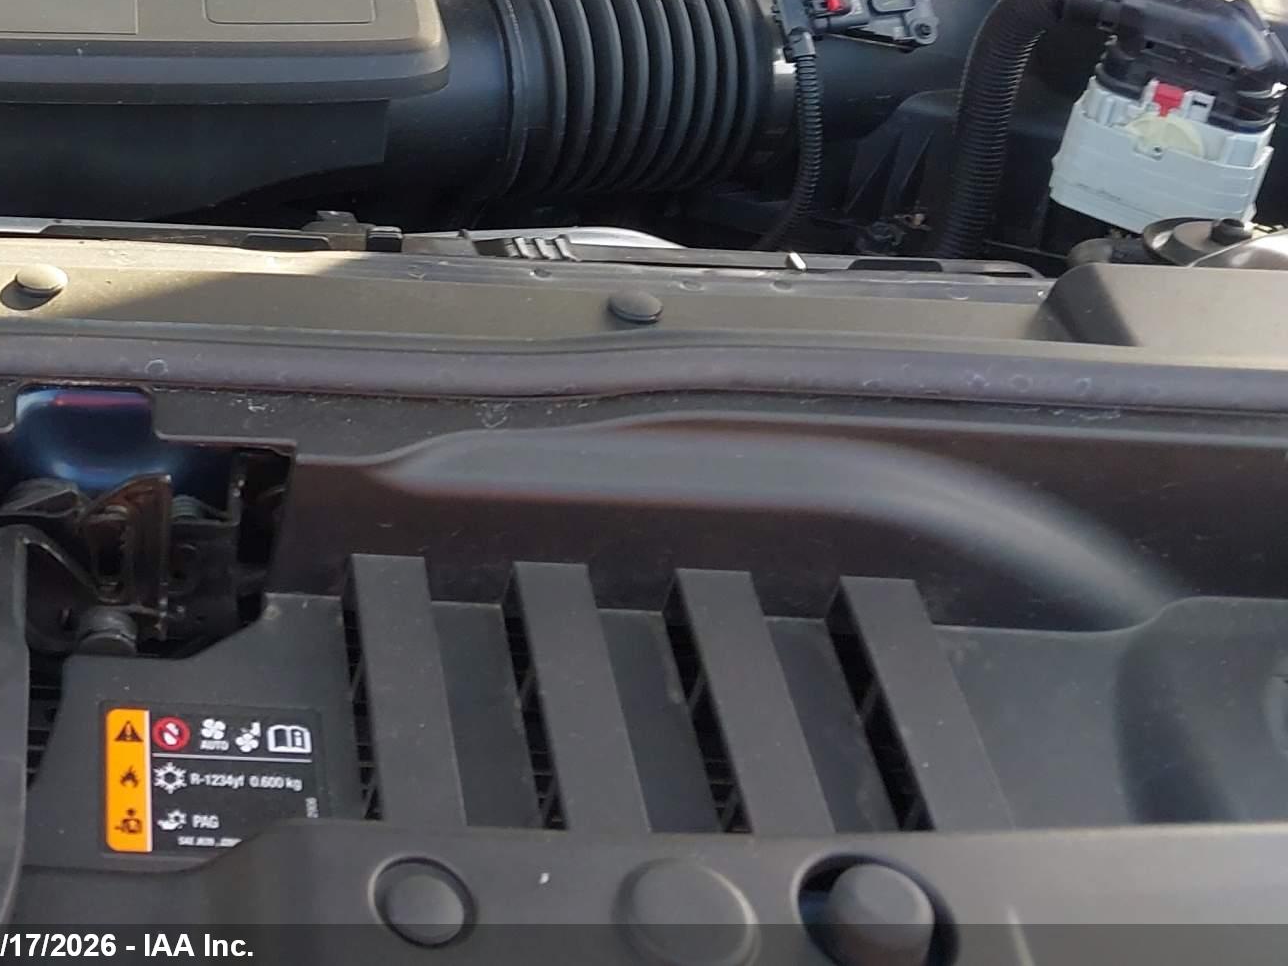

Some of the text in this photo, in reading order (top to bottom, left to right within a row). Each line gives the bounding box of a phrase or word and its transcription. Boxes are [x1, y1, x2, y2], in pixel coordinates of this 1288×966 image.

[200, 740, 229, 751] AUTO
[190, 772, 302, 792] R-1234yf 0.600 kg
[191, 814, 220, 830] PAG
